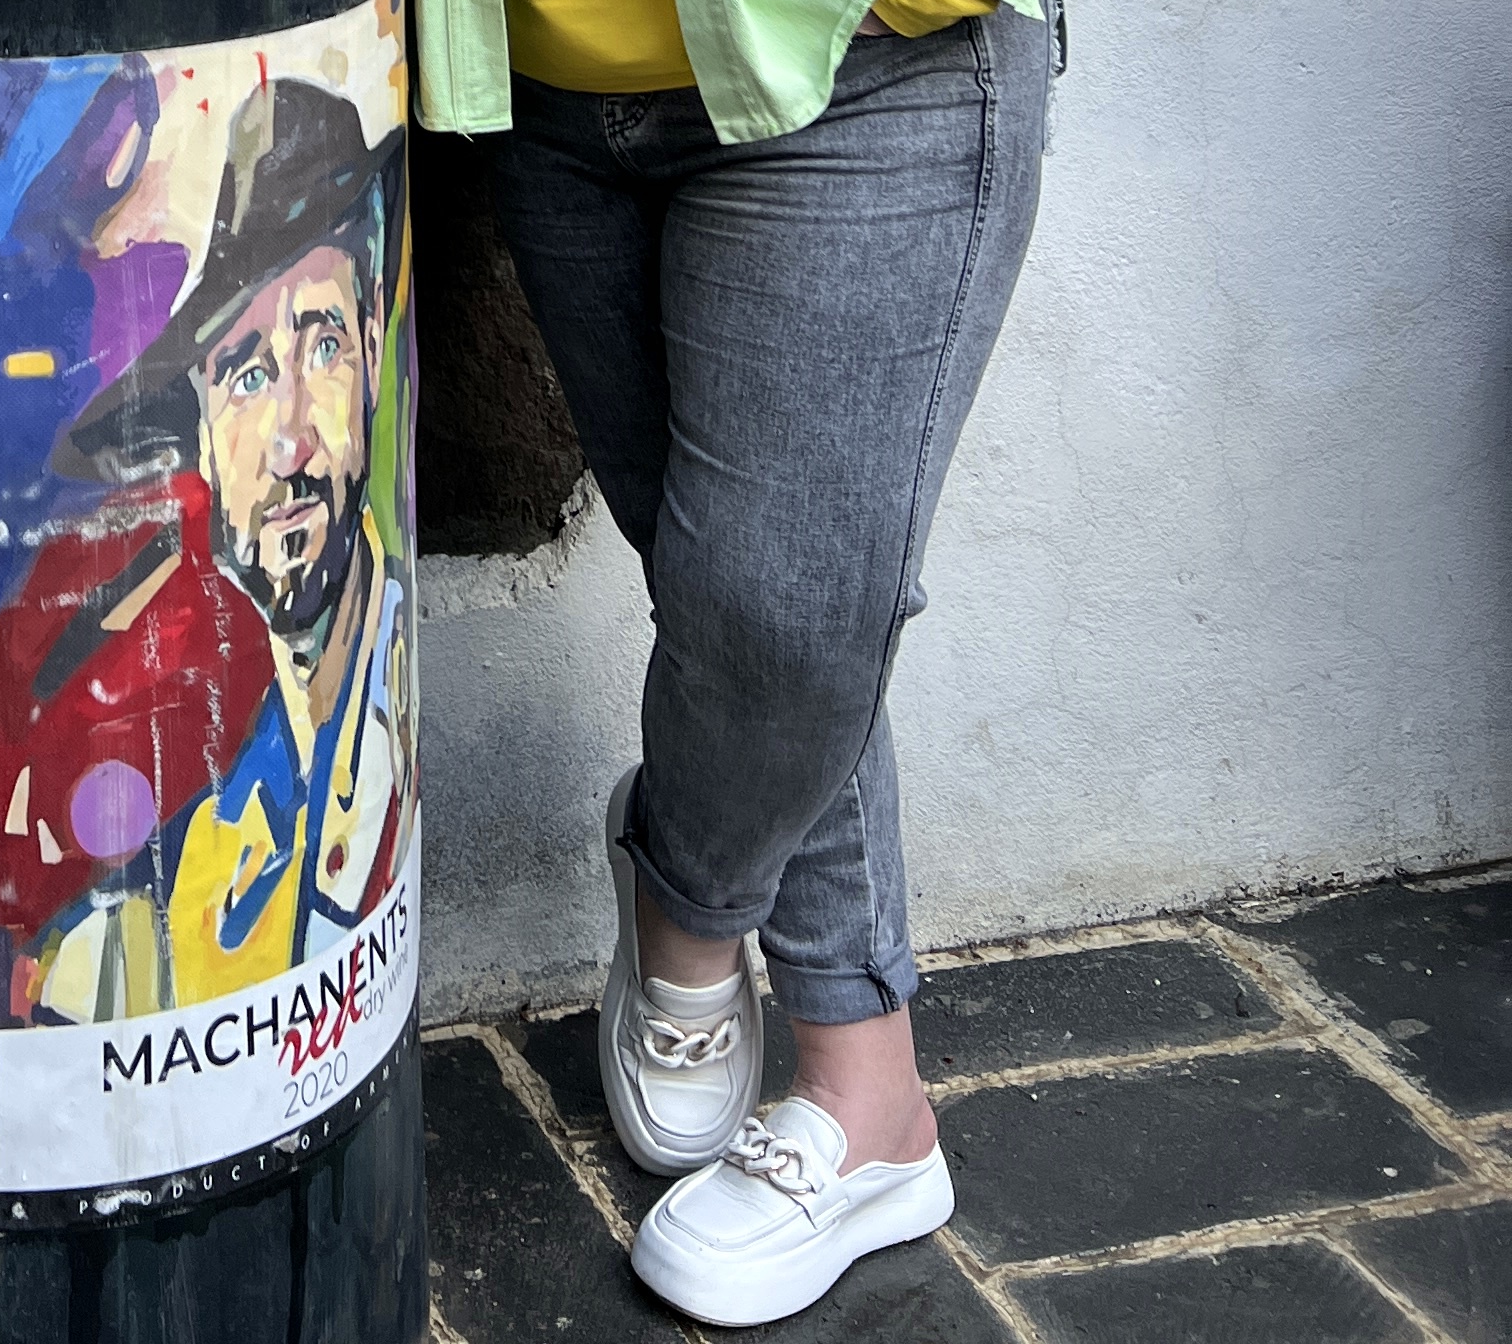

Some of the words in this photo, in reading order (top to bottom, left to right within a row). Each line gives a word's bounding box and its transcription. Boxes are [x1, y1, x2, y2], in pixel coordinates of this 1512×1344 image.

[103, 883, 408, 1093] MACHANENTS
[278, 934, 364, 1077] red
[284, 1050, 349, 1119] 2020
[79, 1155, 266, 1215] PODUCT
